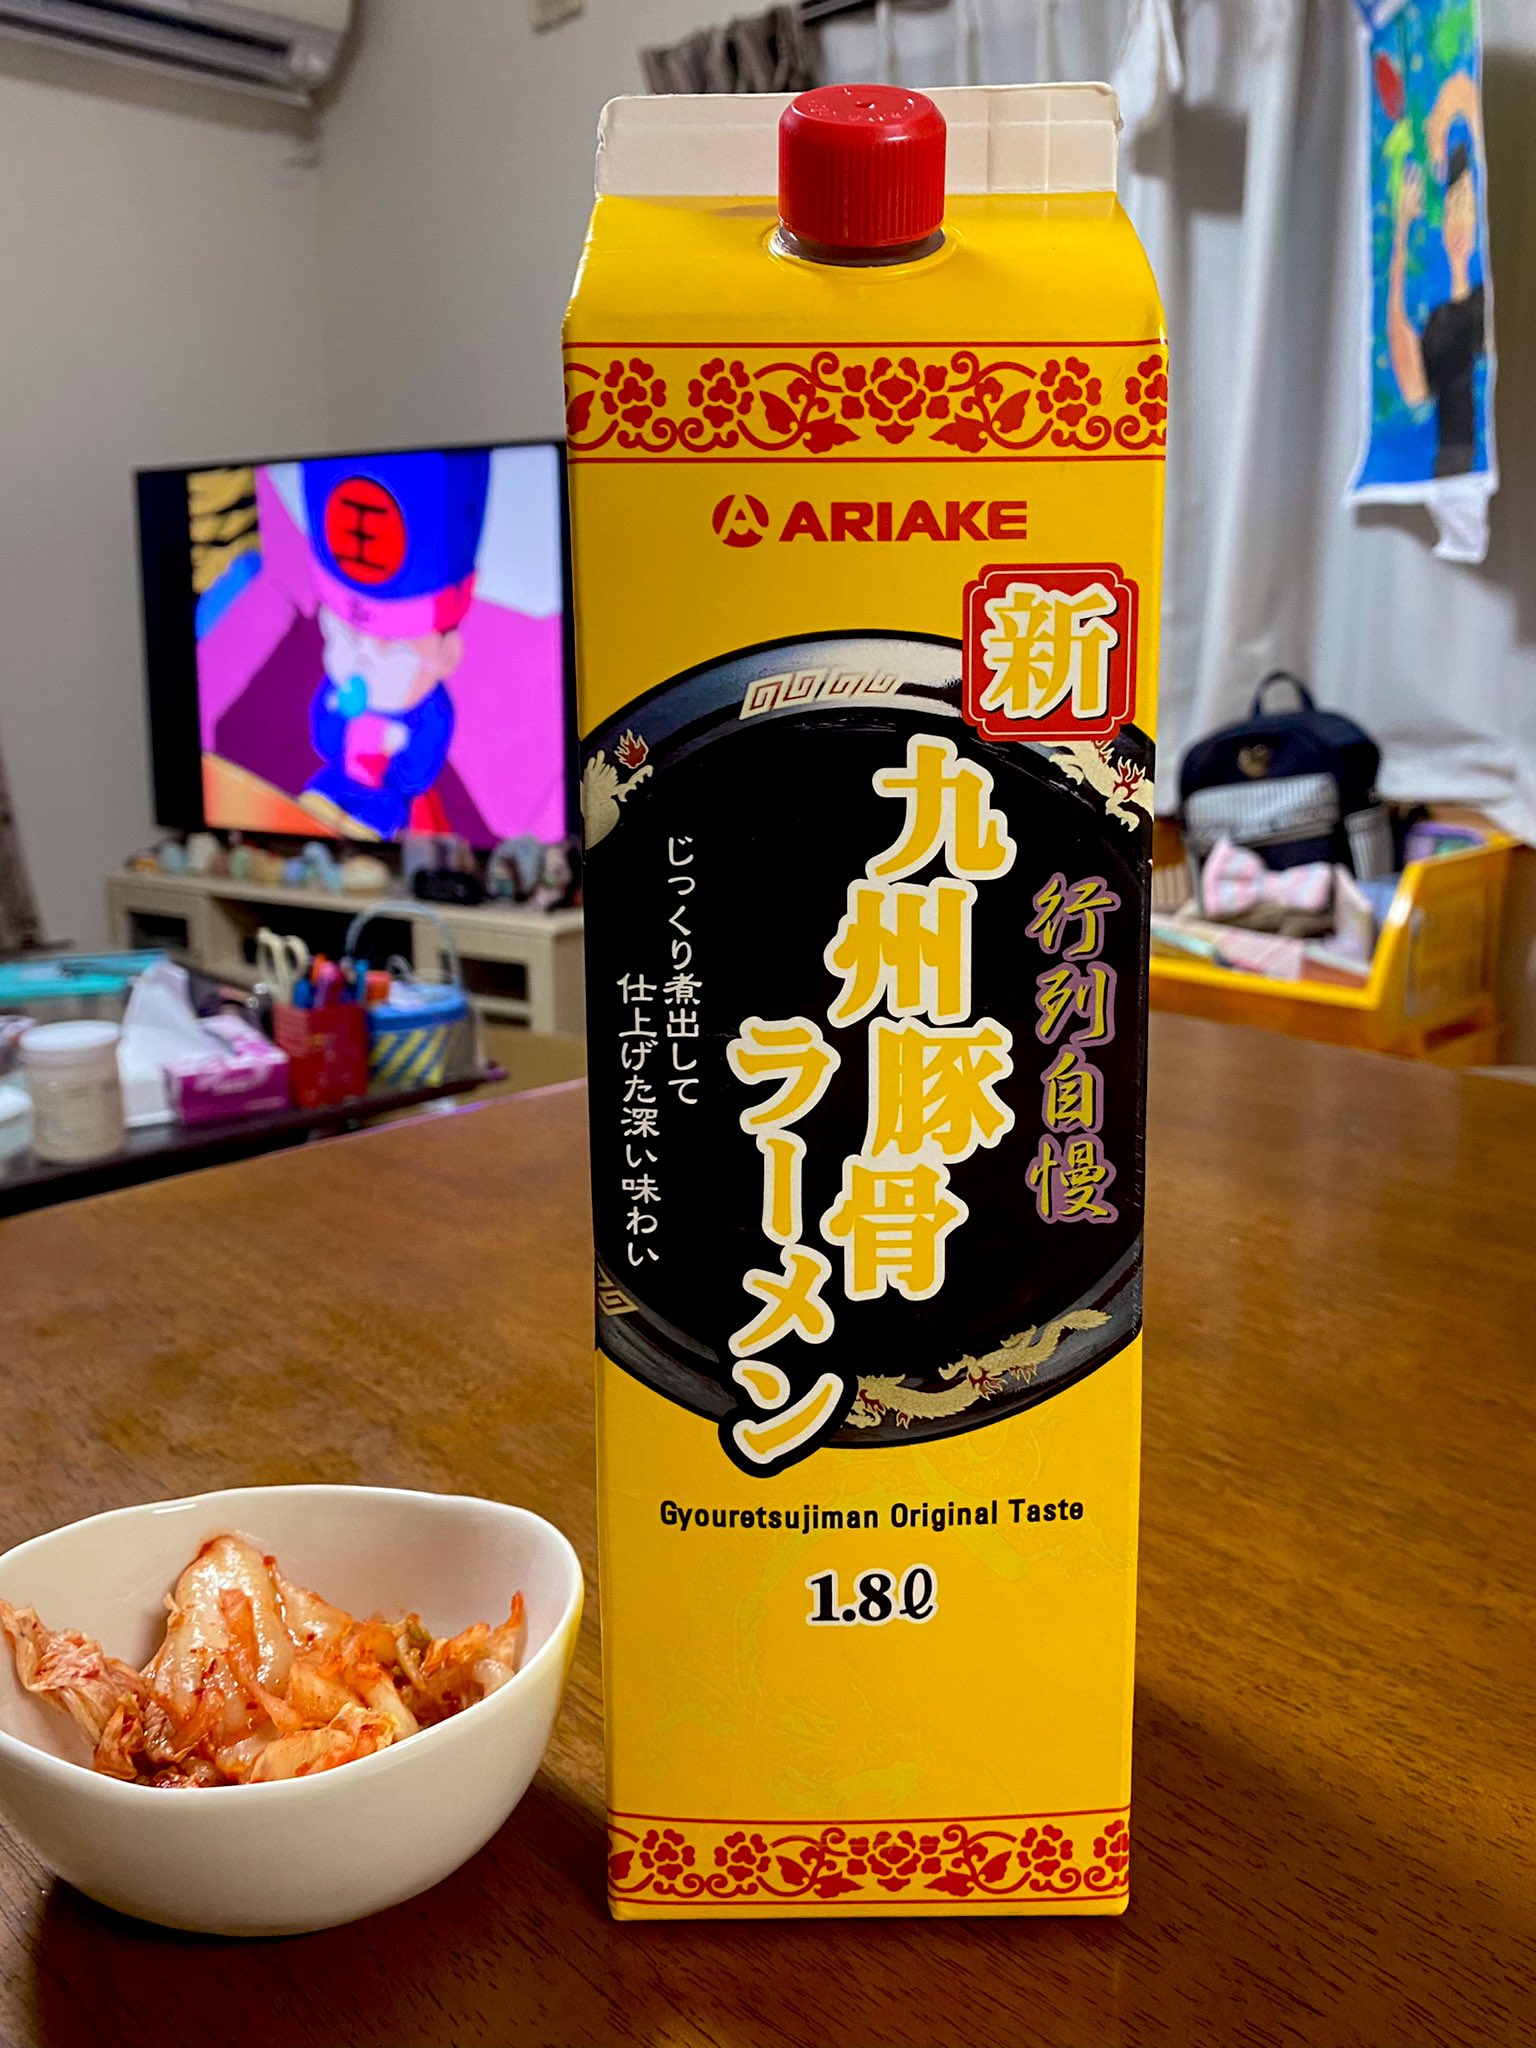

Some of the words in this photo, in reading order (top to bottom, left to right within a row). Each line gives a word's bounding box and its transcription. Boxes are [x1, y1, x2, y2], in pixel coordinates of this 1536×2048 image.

[778, 499, 1028, 542] ARIAKE
[981, 583, 1117, 718] 新
[662, 835, 703, 1105] じっくり煮出して
[822, 735, 1015, 1300] 九州豚骨
[1026, 873, 1121, 1224] 行列自慢
[616, 972, 661, 1266] 仕上げた深い味わい
[728, 1017, 844, 1464] ラーメン
[660, 1500, 879, 1534] Gyouretsujiman
[890, 1499, 998, 1532] Original
[1008, 1497, 1085, 1523] Taste
